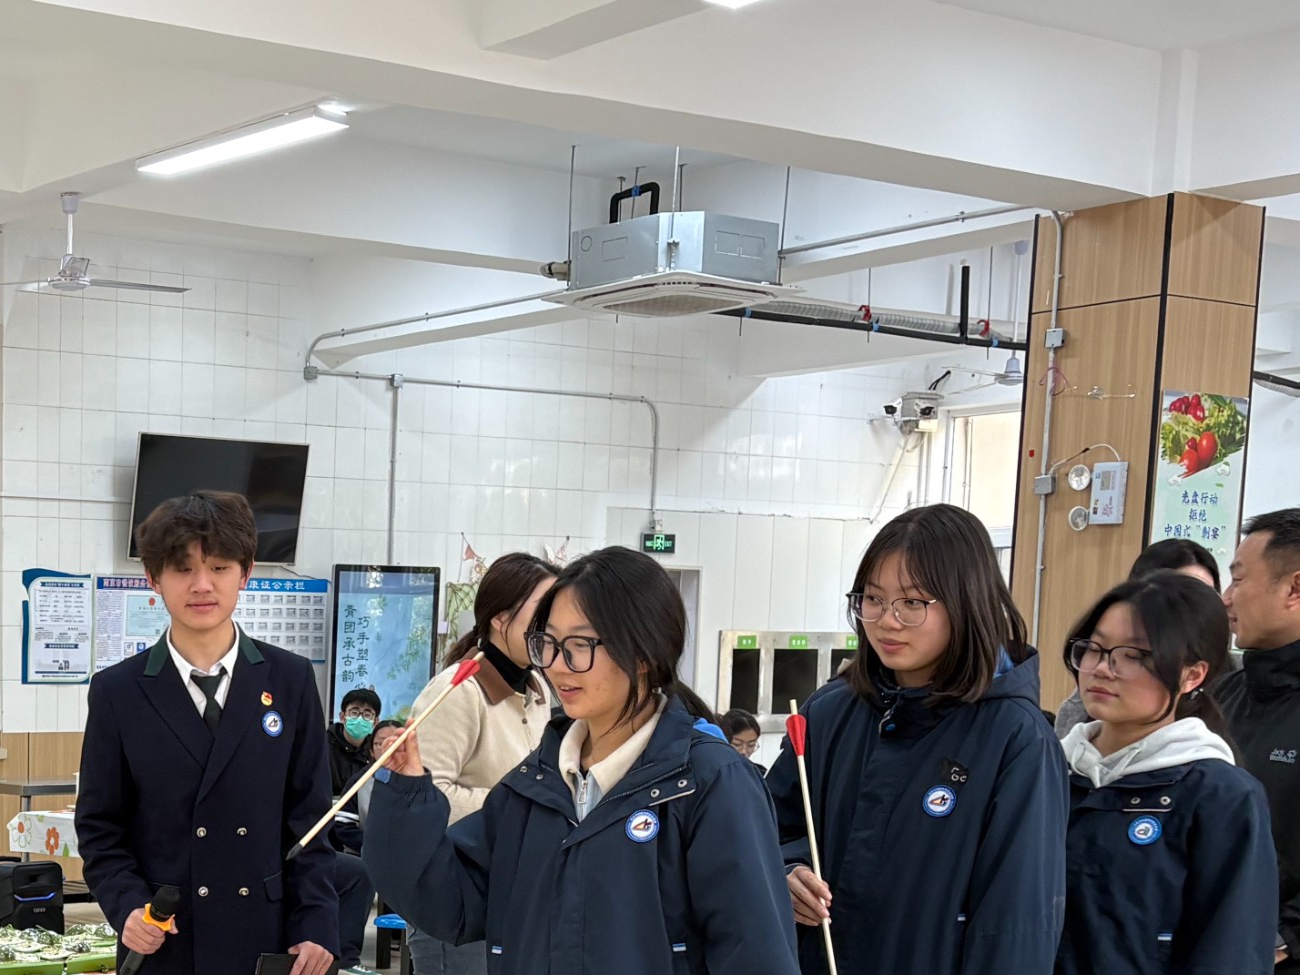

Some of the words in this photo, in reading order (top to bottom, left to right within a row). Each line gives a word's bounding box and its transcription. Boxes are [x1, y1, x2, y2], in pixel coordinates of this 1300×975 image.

[1181, 490, 1218, 506] 光盘行动
[1189, 508, 1207, 522] 拒绝
[245, 580, 305, 590] 康证公示栏
[341, 604, 356, 683] 青团承古韵
